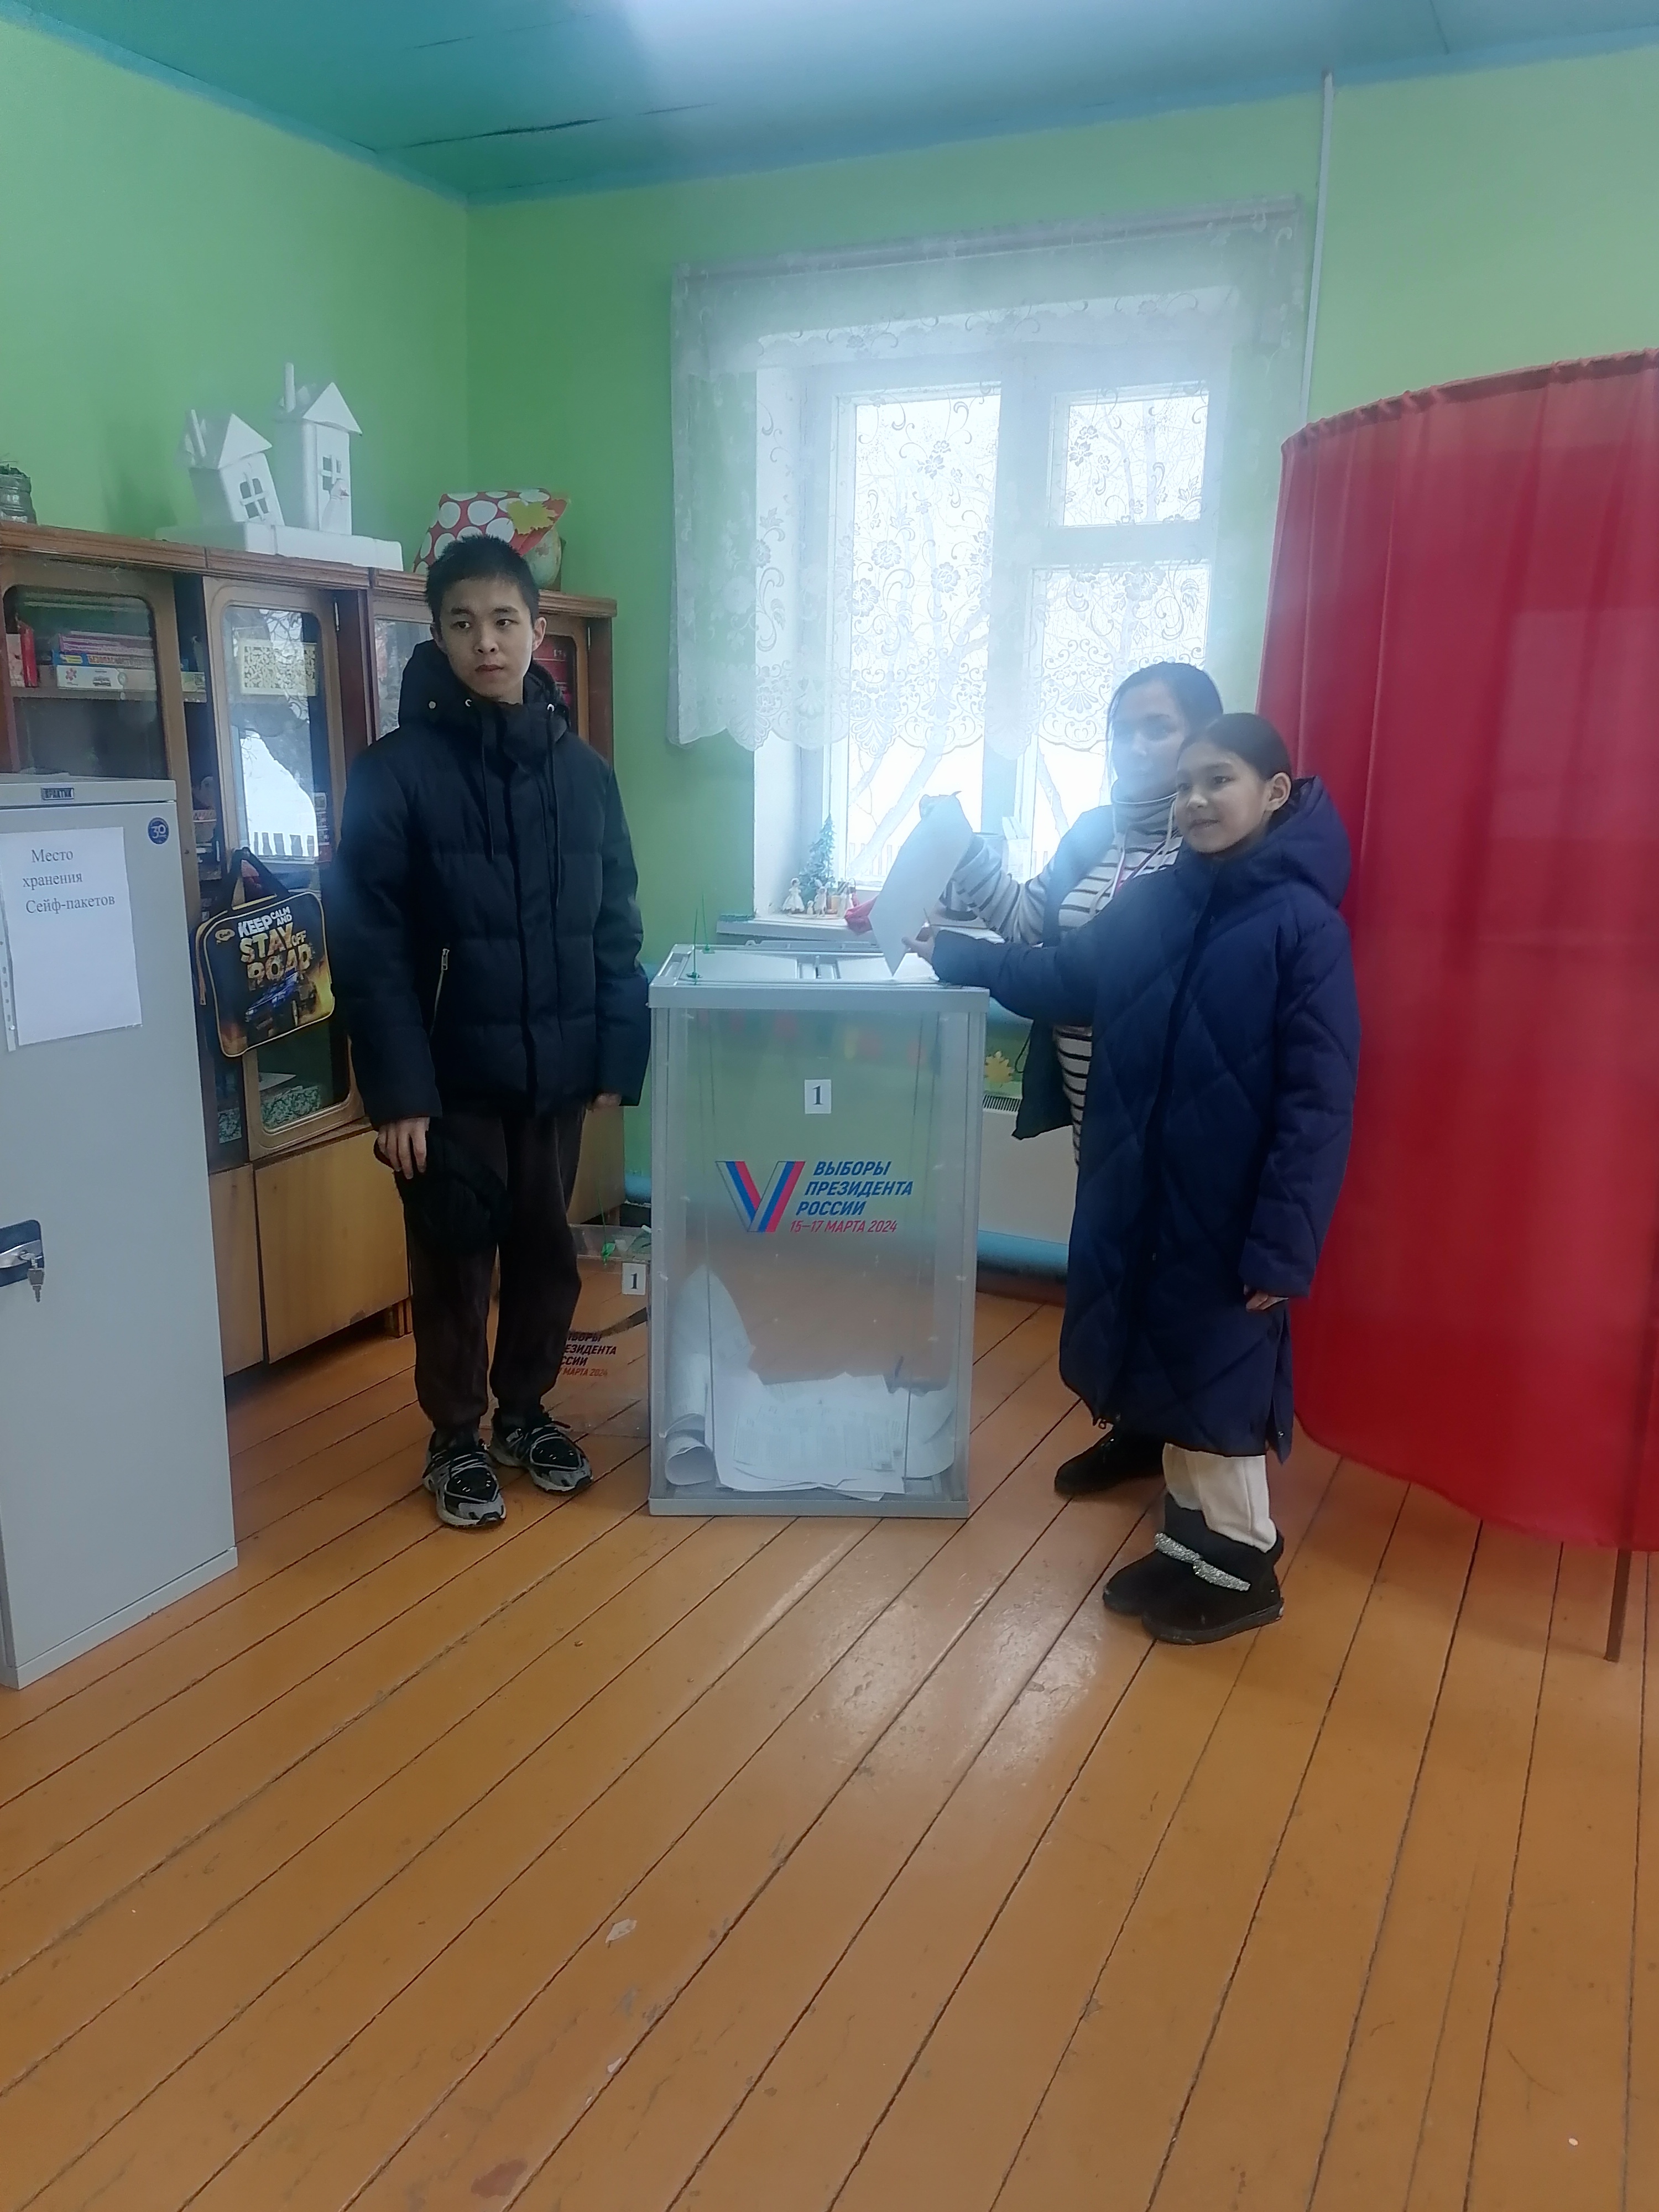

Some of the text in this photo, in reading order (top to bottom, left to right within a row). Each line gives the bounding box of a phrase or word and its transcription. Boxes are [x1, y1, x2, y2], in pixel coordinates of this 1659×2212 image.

[31, 849, 74, 863] Место
[22, 873, 83, 890] хранения
[25, 896, 115, 914] Сейф-пакетов
[238, 915, 273, 937] KEEP
[270, 906, 290, 920] CALM
[276, 914, 293, 926] AND
[239, 922, 306, 962] STAY OFF
[247, 943, 312, 990] ROAD
[812, 1085, 823, 1105] 1
[813, 1161, 891, 1176] ВЫБОРЫ
[804, 1181, 914, 1197] ПРЕЗИДЕНТА
[796, 1201, 867, 1216] РОССИИ
[825, 1220, 866, 1233] МАРТА
[868, 1220, 897, 1233] 2024
[630, 1273, 638, 1290] 1
[564, 1344, 617, 1355] ЕЗИДЕНТА
[563, 1367, 588, 1376] МАРТА
